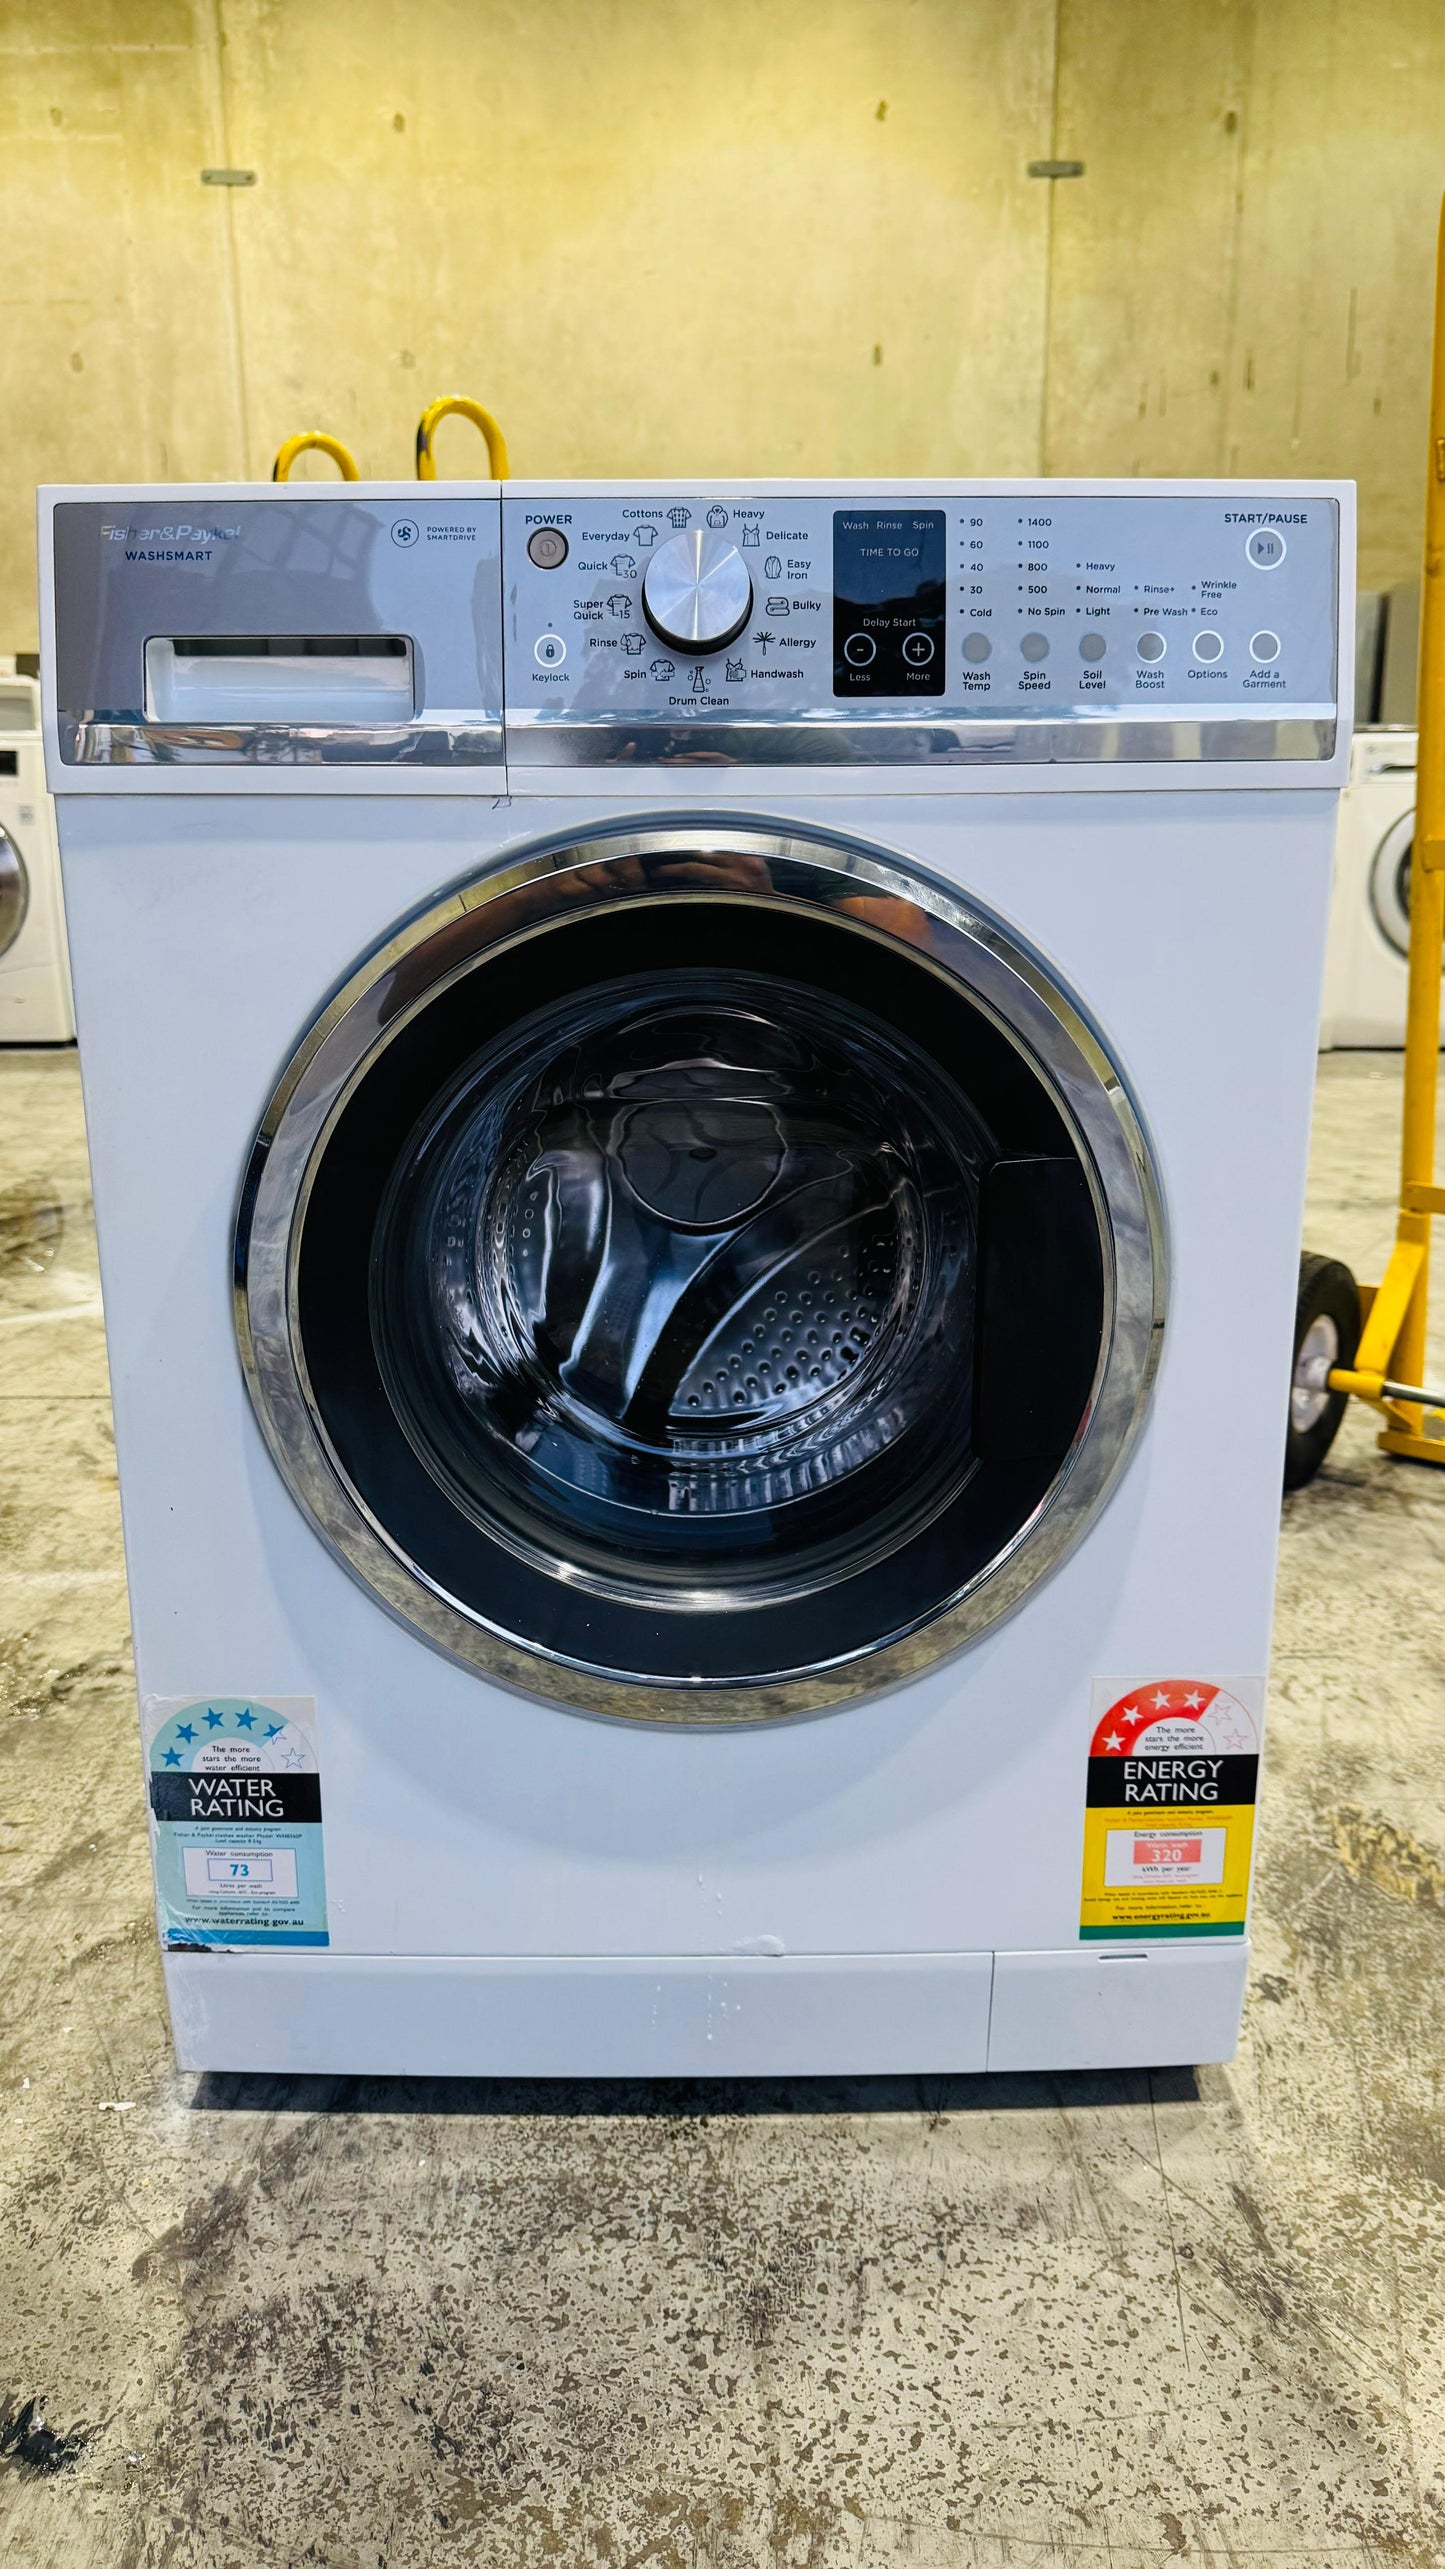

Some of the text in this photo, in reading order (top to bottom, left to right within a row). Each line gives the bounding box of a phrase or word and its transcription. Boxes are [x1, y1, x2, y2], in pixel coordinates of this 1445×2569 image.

[623, 510, 663, 518] Cottons
[734, 510, 764, 519] Heavy
[1225, 513, 1307, 524] START/PAUSE
[526, 515, 572, 524] POWER
[877, 521, 902, 529] Rinse
[913, 521, 933, 530] Spin
[582, 532, 630, 542] Everyday
[767, 531, 808, 539] Delicate
[125, 551, 212, 560] WASHSMART
[860, 548, 919, 556] TIME TO GO
[578, 562, 607, 570] Quick
[788, 560, 811, 569] Easy
[971, 563, 983, 571] 40
[1028, 563, 1047, 571] 800
[1087, 563, 1115, 571] Heavy
[624, 569, 637, 578] 30
[788, 571, 807, 579] Iron
[1144, 585, 1174, 593] Rinse+
[1201, 581, 1237, 589] Wrinkle
[970, 586, 982, 594] 30
[574, 600, 604, 610] Super
[793, 601, 821, 611] Bulky
[574, 611, 603, 620] Quick
[620, 610, 630, 619] 15
[970, 609, 992, 617] Cold
[1045, 608, 1065, 616] Spin
[1086, 608, 1110, 617] Light
[1162, 608, 1187, 616] Wash
[864, 618, 916, 628] Delay Start
[590, 639, 617, 647] Rinse
[779, 638, 816, 648] Allergy
[532, 673, 569, 683] Keylock
[624, 670, 646, 679] Spin
[751, 669, 803, 678] Handwash
[963, 672, 990, 680] Wash
[1024, 671, 1045, 681] Spin
[1084, 671, 1102, 679] Soil
[1188, 670, 1227, 679] Options
[1250, 670, 1270, 678] Add
[963, 682, 990, 691] Temp
[1019, 681, 1050, 691] Speed
[1080, 681, 1105, 689] Level
[1136, 680, 1164, 688] Boost
[1243, 680, 1286, 688] Garment
[669, 697, 729, 705] Drum Clean
[1124, 1760, 1223, 1779] ENERGY
[188, 1779, 276, 1796] WATER
[1125, 1782, 1218, 1801] RATING
[191, 1799, 283, 1816] RATING
[1134, 1831, 1156, 1839] Energy
[1152, 1849, 1182, 1862] 320
[230, 1864, 249, 1876] 73
